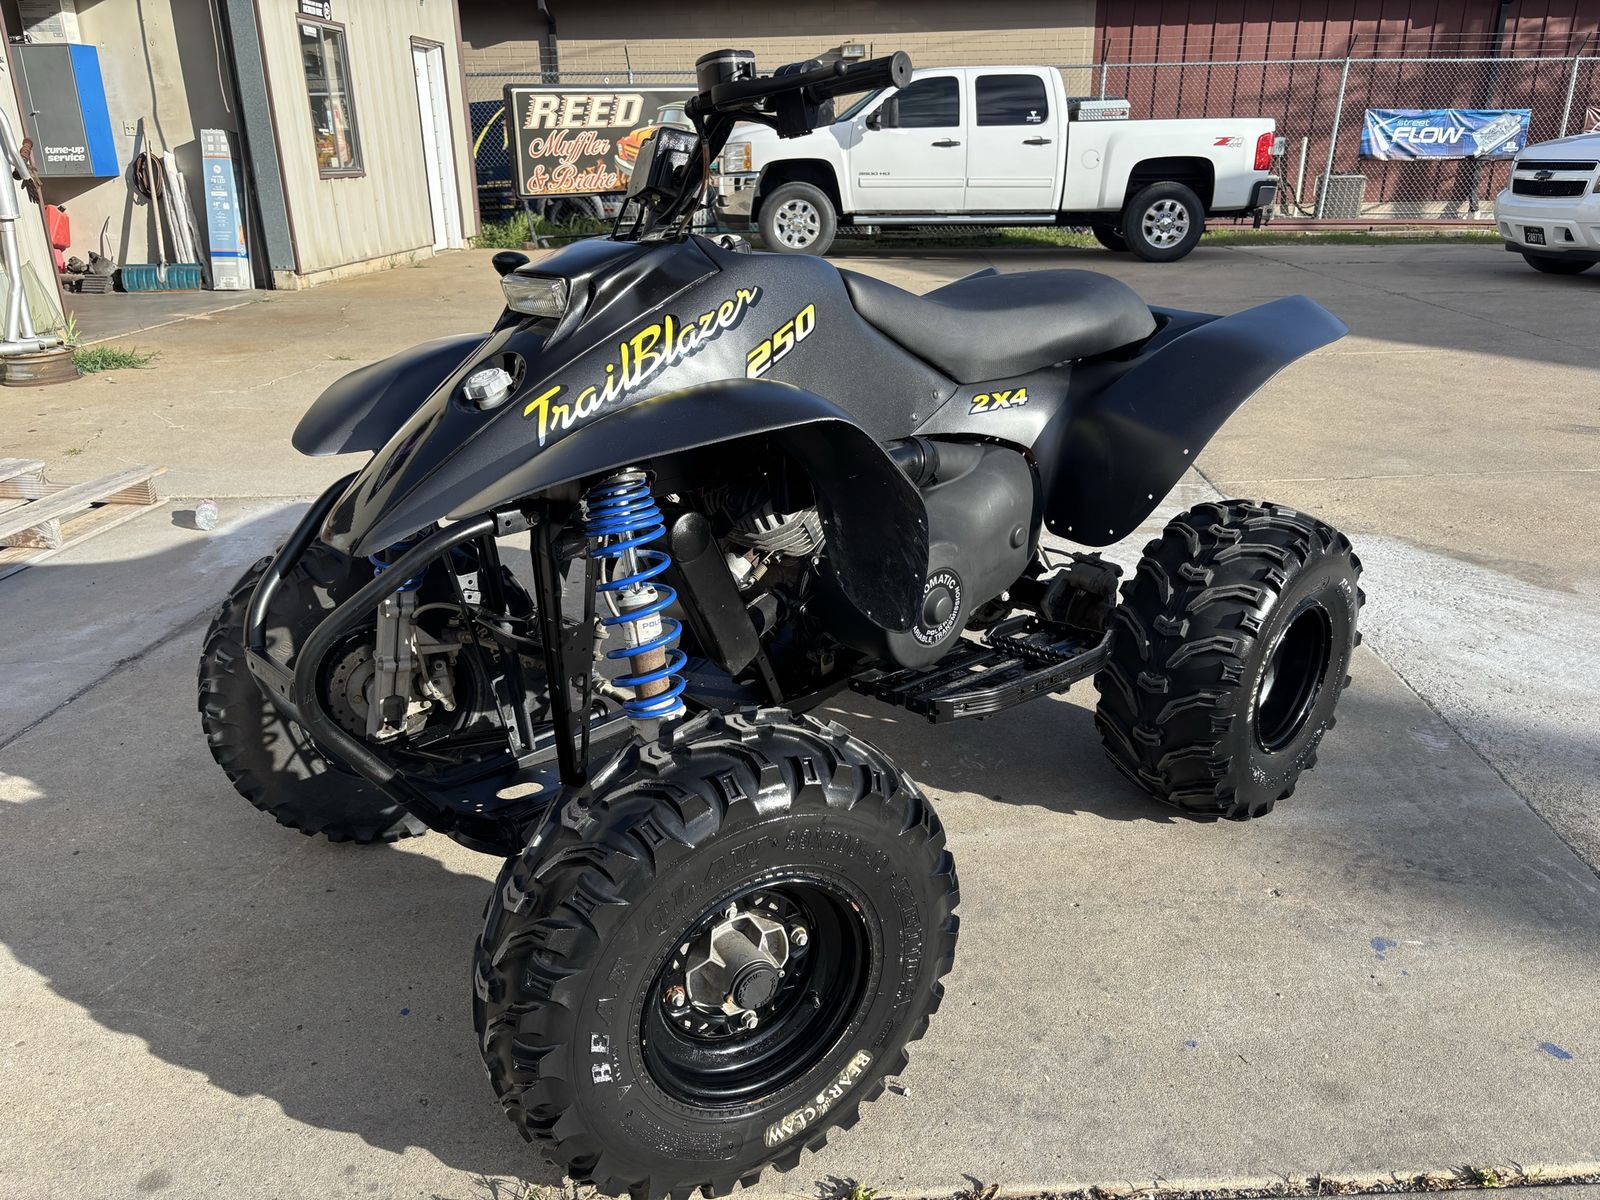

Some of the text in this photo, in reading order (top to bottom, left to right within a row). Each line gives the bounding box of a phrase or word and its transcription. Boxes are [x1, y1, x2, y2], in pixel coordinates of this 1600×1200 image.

[523, 94, 645, 129] REED
[1396, 119, 1431, 127] street
[44, 146, 85, 154] tune-up
[529, 129, 611, 164] Muffler
[1391, 127, 1466, 144] FLOW
[47, 153, 86, 162] service
[527, 163, 618, 193] & Brake
[746, 303, 816, 378] 250
[523, 286, 760, 446] TrailBlazer
[969, 387, 1029, 415] 2X4
[923, 574, 956, 598] OMATIC
[912, 625, 933, 643] ARIABLE
[828, 1052, 872, 1099] BEAR
[768, 1107, 817, 1146] CLAW
